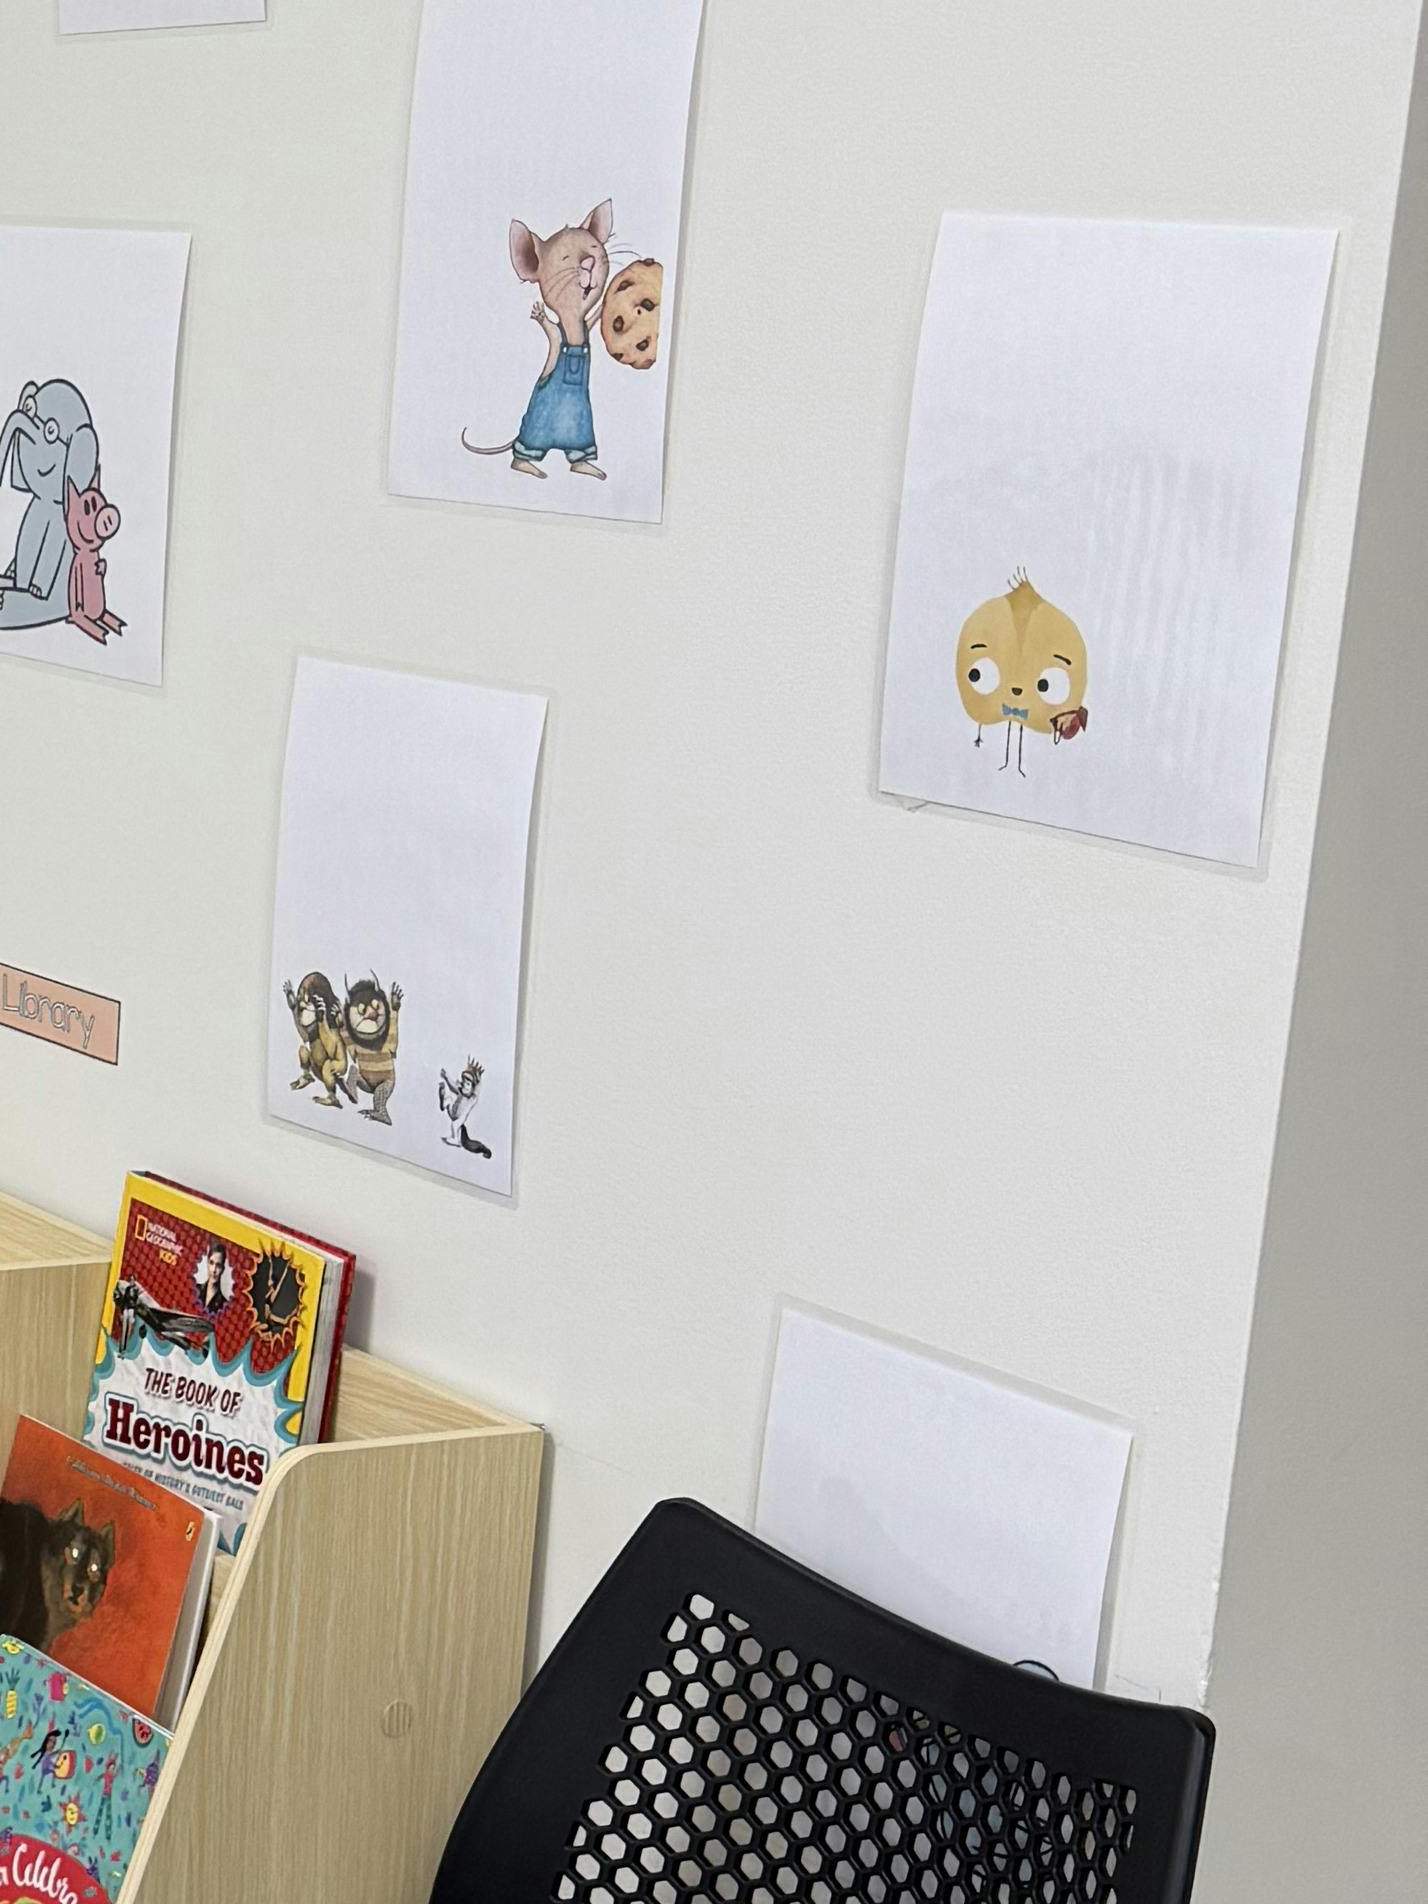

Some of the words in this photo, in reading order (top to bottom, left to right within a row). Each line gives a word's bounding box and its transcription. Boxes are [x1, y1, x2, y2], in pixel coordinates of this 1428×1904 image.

[2, 972, 96, 1050] Library
[144, 1367, 174, 1395] THE
[175, 1375, 219, 1408] BOOK
[220, 1389, 242, 1414] OF
[105, 1397, 266, 1486] Heroines
